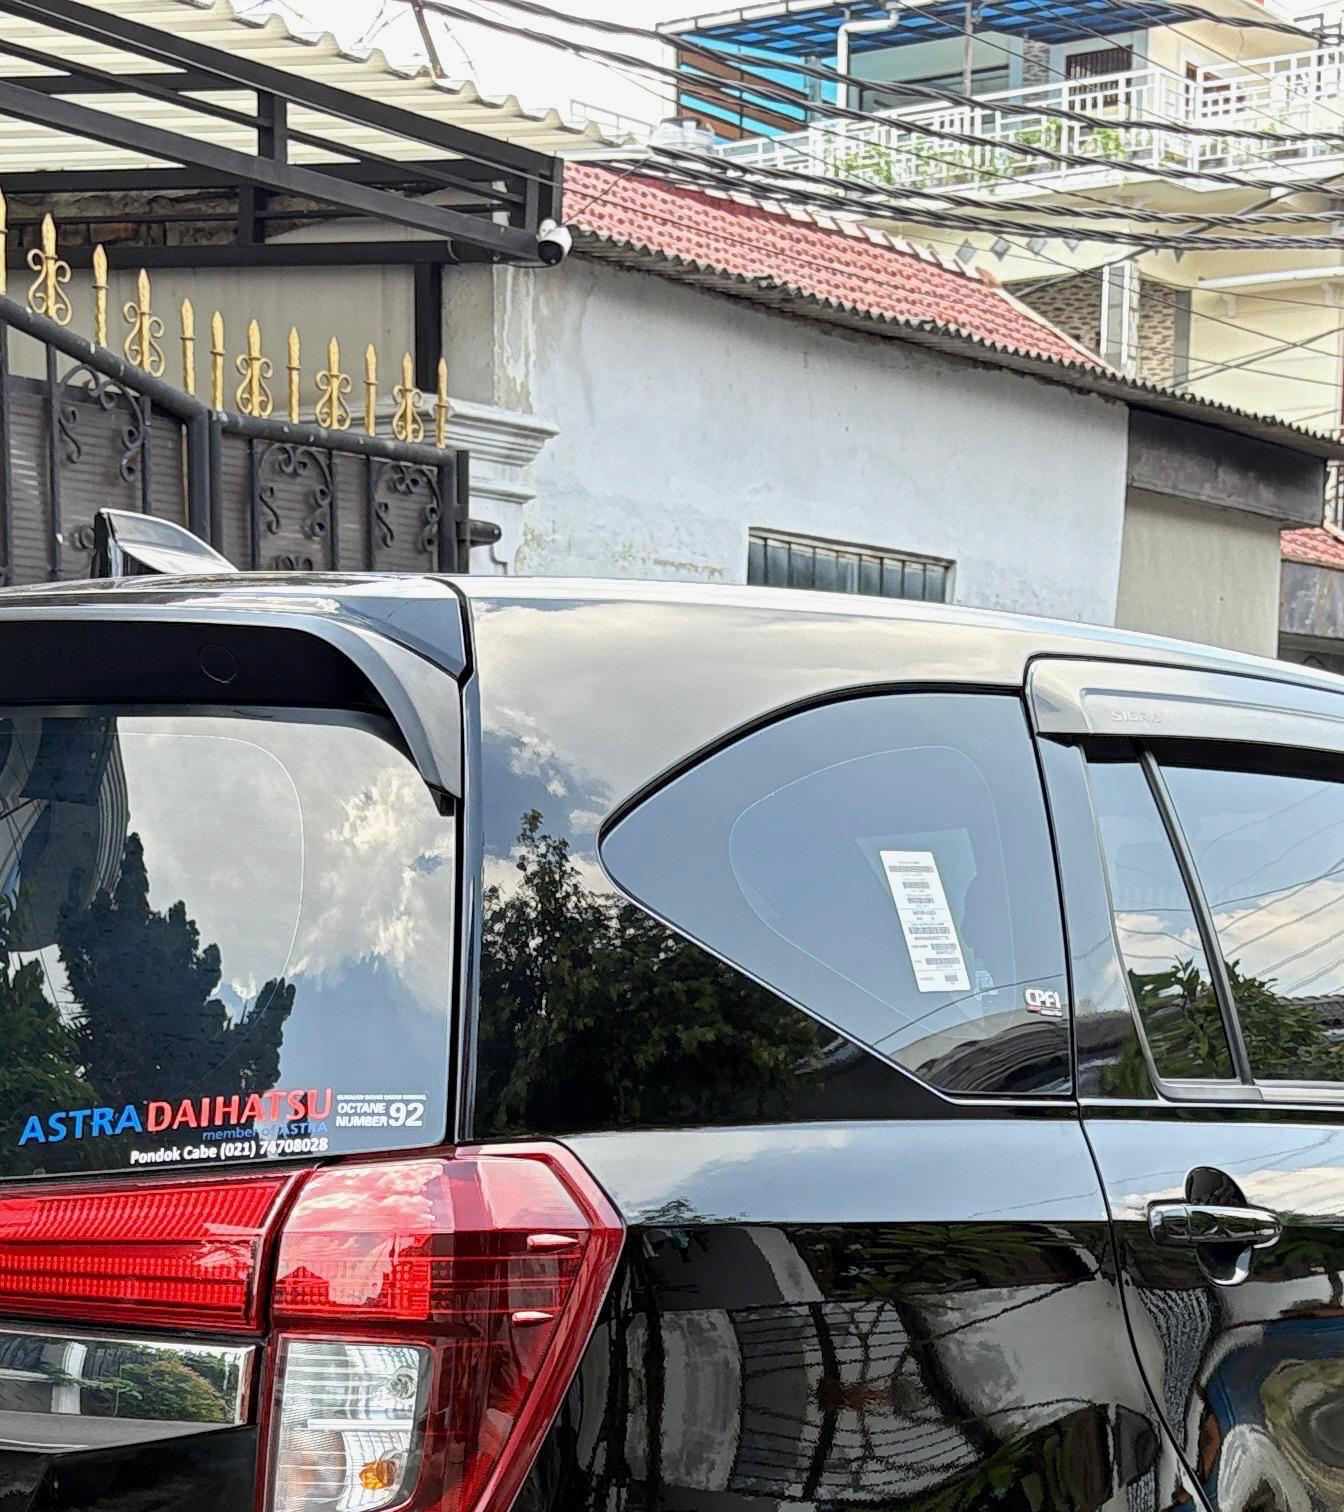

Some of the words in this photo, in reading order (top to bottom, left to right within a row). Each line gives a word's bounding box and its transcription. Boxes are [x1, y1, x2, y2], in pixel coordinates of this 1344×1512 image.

[17, 1104, 143, 1146] ASTRA
[146, 1088, 333, 1132] DAIHATSU
[336, 1115, 388, 1127] NUMBER
[388, 1102, 425, 1127] 92
[337, 1102, 387, 1114] OCTANE
[203, 1126, 256, 1141] member
[278, 1121, 329, 1136] ASTRA
[130, 1146, 181, 1165] Pondok
[183, 1143, 218, 1161] Cabe
[220, 1140, 257, 1160] (021)
[259, 1136, 329, 1155] 74708028
